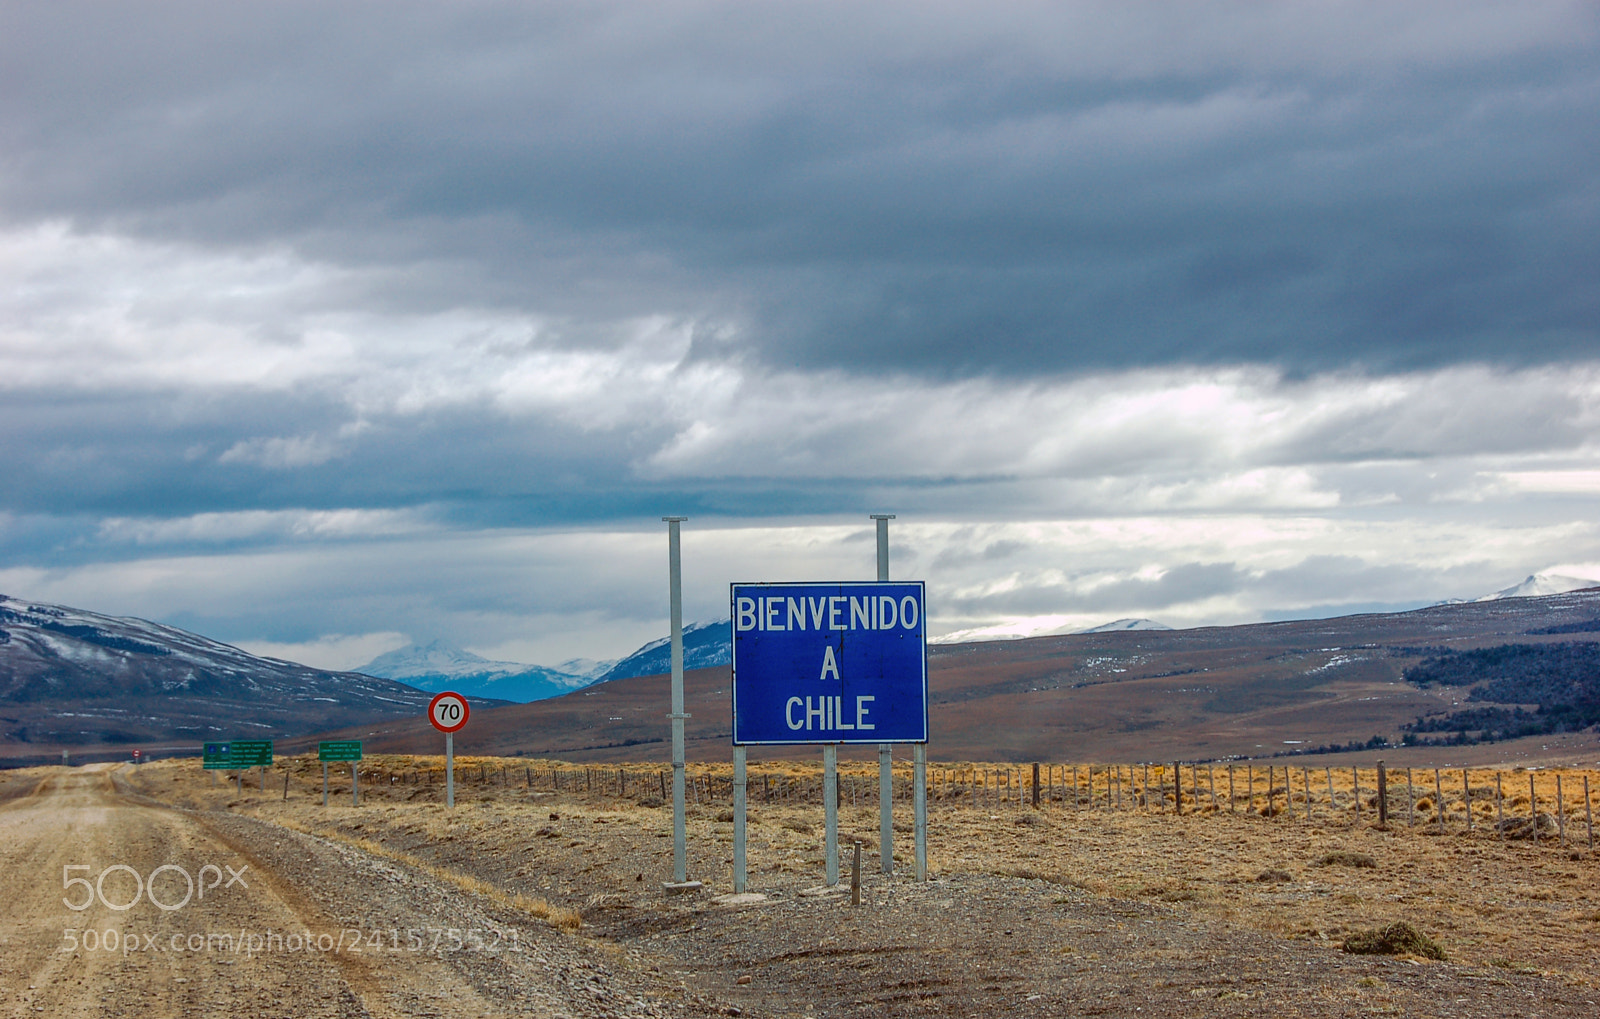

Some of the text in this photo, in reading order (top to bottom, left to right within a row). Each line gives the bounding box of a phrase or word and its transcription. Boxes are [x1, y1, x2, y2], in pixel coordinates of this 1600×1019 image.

[736, 595, 919, 632] BIENVENIDO
[819, 645, 840, 680] A
[438, 703, 460, 720] 70
[785, 695, 876, 731] CHILE
